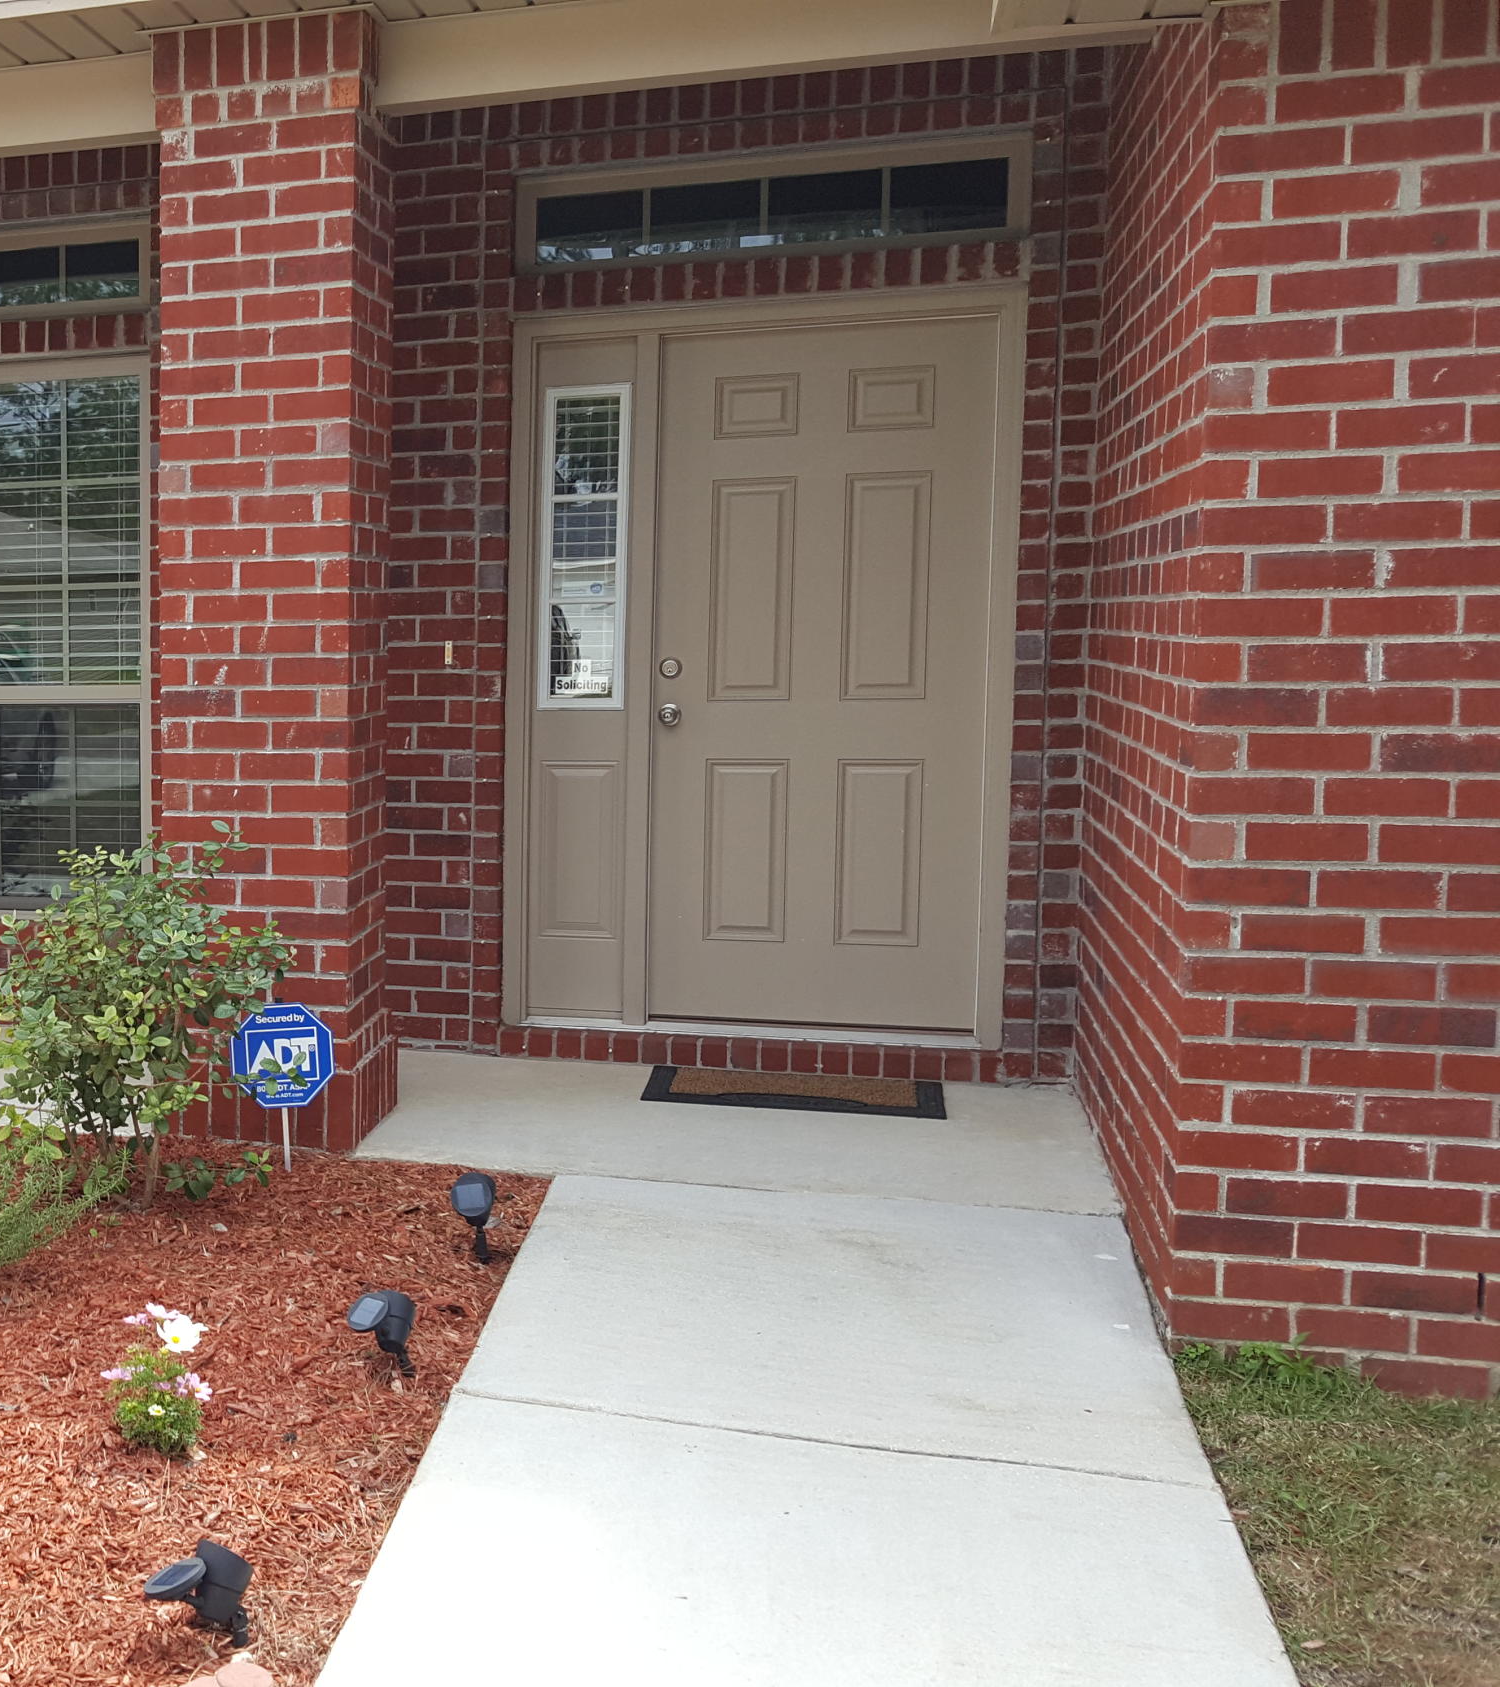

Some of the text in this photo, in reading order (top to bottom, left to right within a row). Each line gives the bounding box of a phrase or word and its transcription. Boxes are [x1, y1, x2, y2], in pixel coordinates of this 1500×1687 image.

[574, 663, 588, 672] No
[556, 679, 607, 692] Soliciting
[255, 1013, 305, 1024] Secured by
[250, 1037, 316, 1075] ADT
